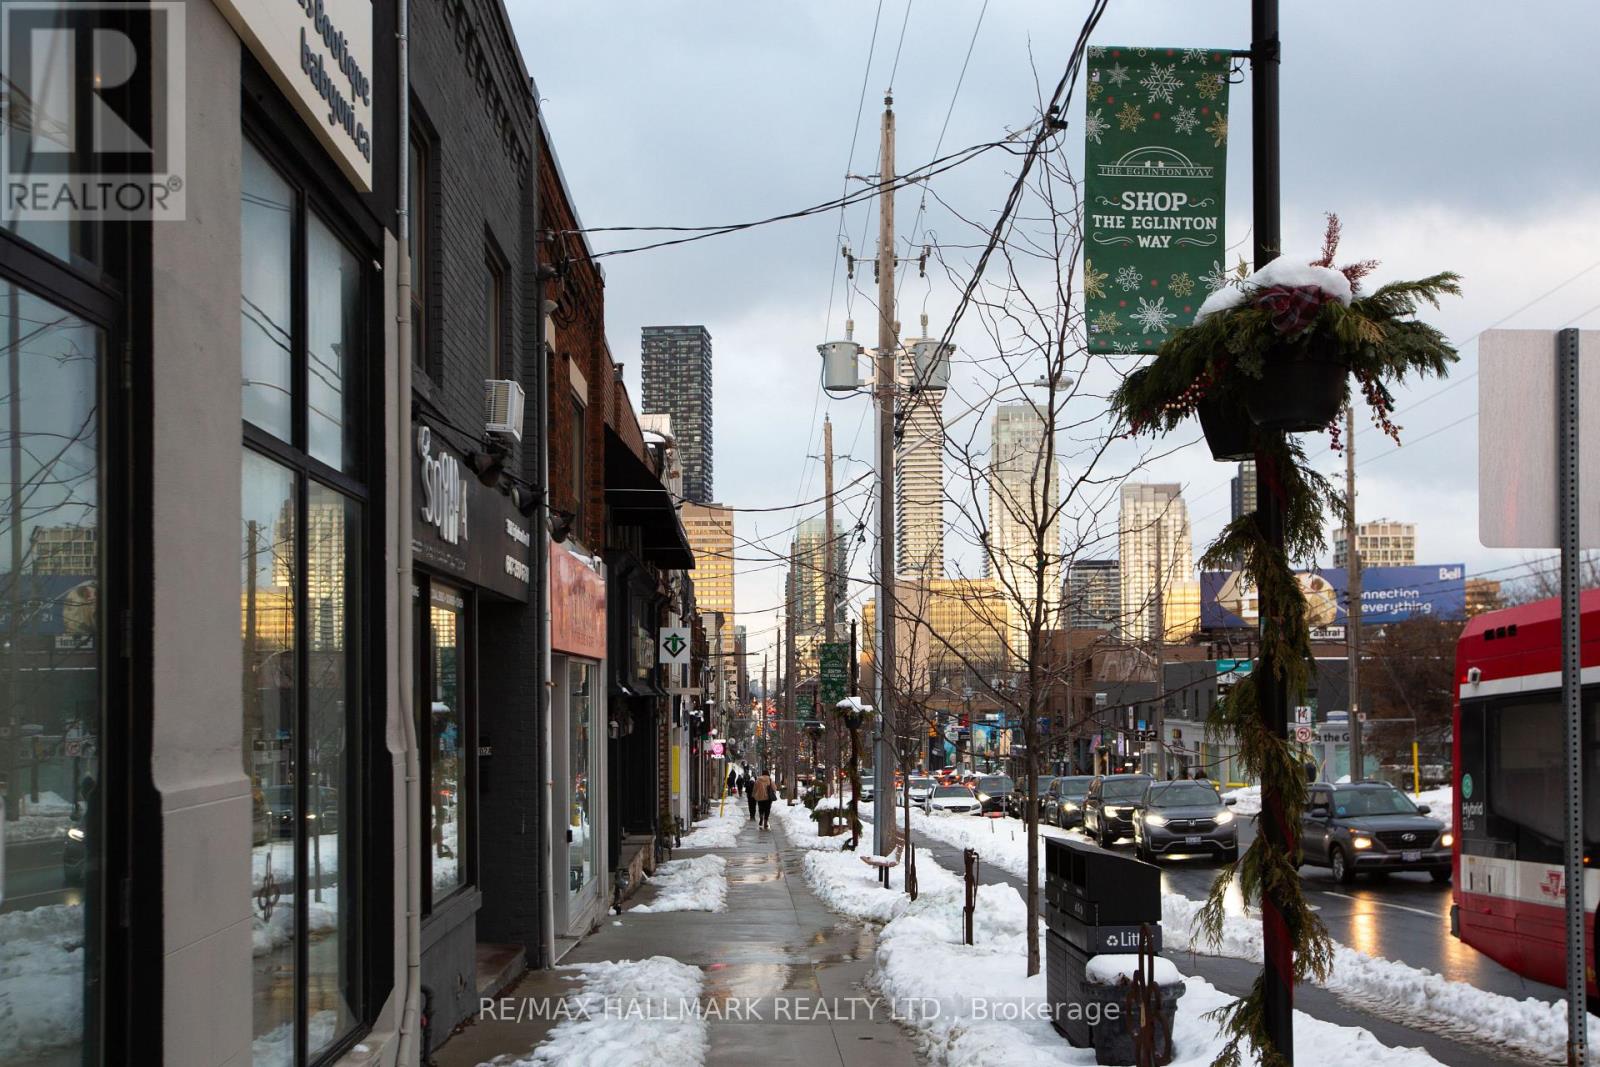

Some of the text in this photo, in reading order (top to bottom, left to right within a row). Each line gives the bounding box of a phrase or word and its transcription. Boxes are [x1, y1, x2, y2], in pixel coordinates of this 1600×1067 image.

[300, 26, 371, 164] babyuni.ca
[1100, 167, 1212, 176] THE EGLINTON WAY
[1121, 191, 1188, 212] SHOP
[1092, 215, 1218, 230] THE EGLINTON
[1137, 235, 1172, 248] WAY
[1439, 568, 1461, 580] Bell
[1361, 601, 1432, 614] everything
[1324, 732, 1340, 742] the
[1462, 802, 1483, 817] Hybrid
[1462, 817, 1475, 830] Bus
